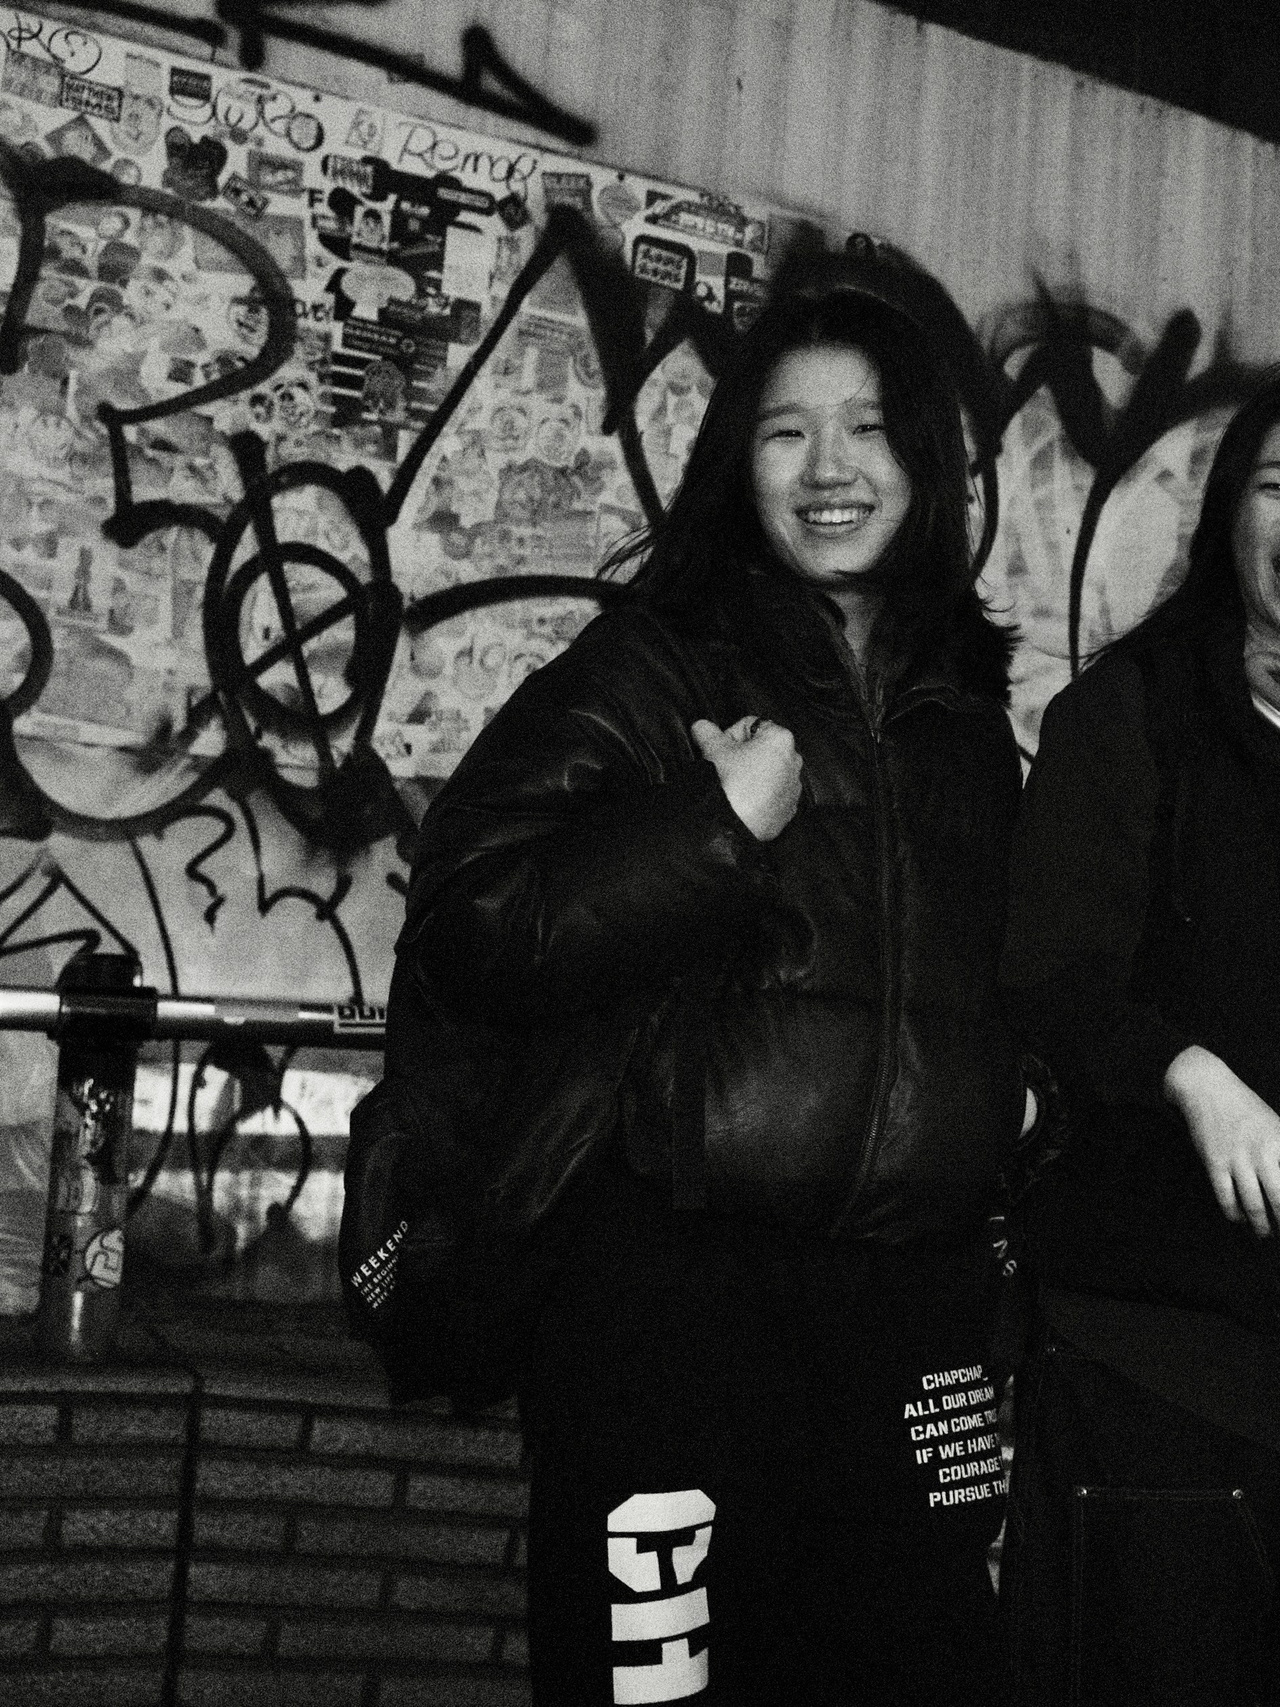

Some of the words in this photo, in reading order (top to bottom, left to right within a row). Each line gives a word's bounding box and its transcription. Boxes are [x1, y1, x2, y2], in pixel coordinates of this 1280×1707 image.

[351, 1221, 408, 1287] WEEKEND
[904, 1399, 940, 1419] ALL
[942, 1392, 968, 1410] OUR
[910, 1420, 949, 1441] CAN
[950, 1413, 985, 1433] COME
[916, 1447, 934, 1464] IF
[938, 1441, 965, 1460] WE
[967, 1434, 996, 1453] HAVE
[938, 1457, 1000, 1483] COURAGE
[929, 1483, 992, 1507] PURSUE
